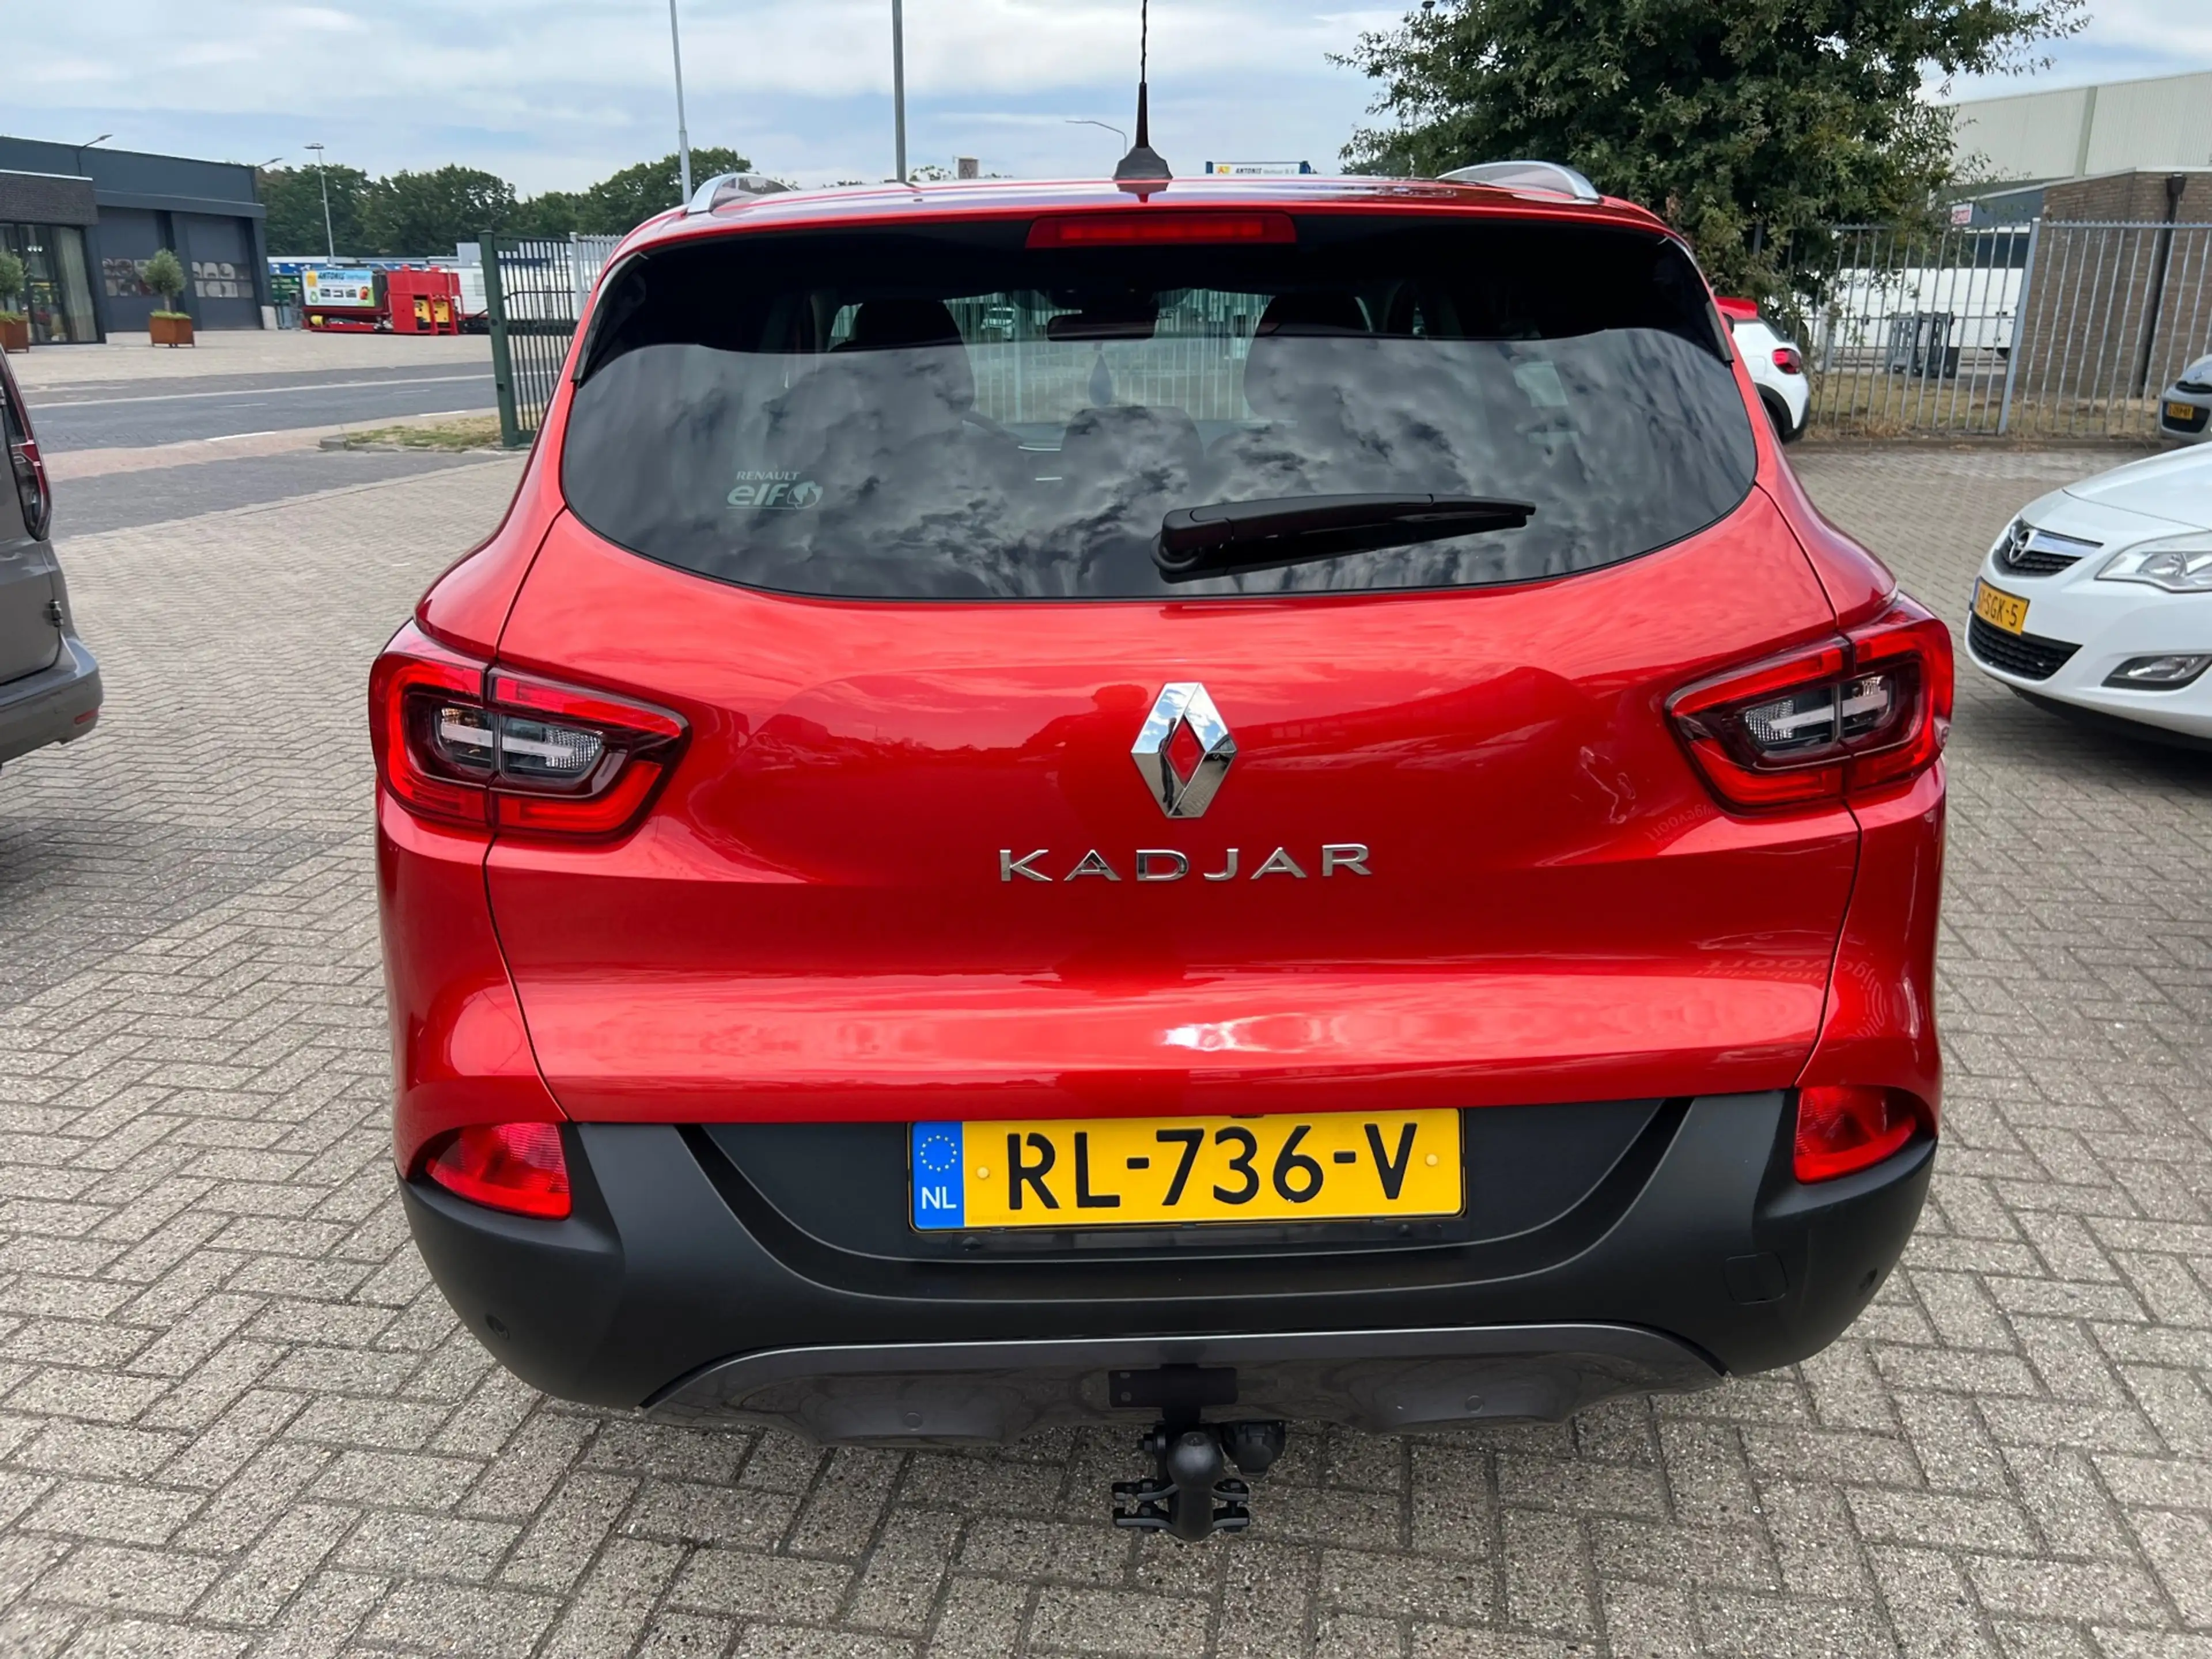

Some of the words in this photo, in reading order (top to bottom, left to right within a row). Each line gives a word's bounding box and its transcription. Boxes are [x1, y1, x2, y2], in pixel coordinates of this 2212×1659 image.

[736, 471, 800, 481] RENAULT
[727, 483, 789, 506] elf
[999, 843, 1373, 882] KADJAR
[1006, 1122, 1418, 1210] RL-736-V
[921, 1185, 957, 1210] NL
